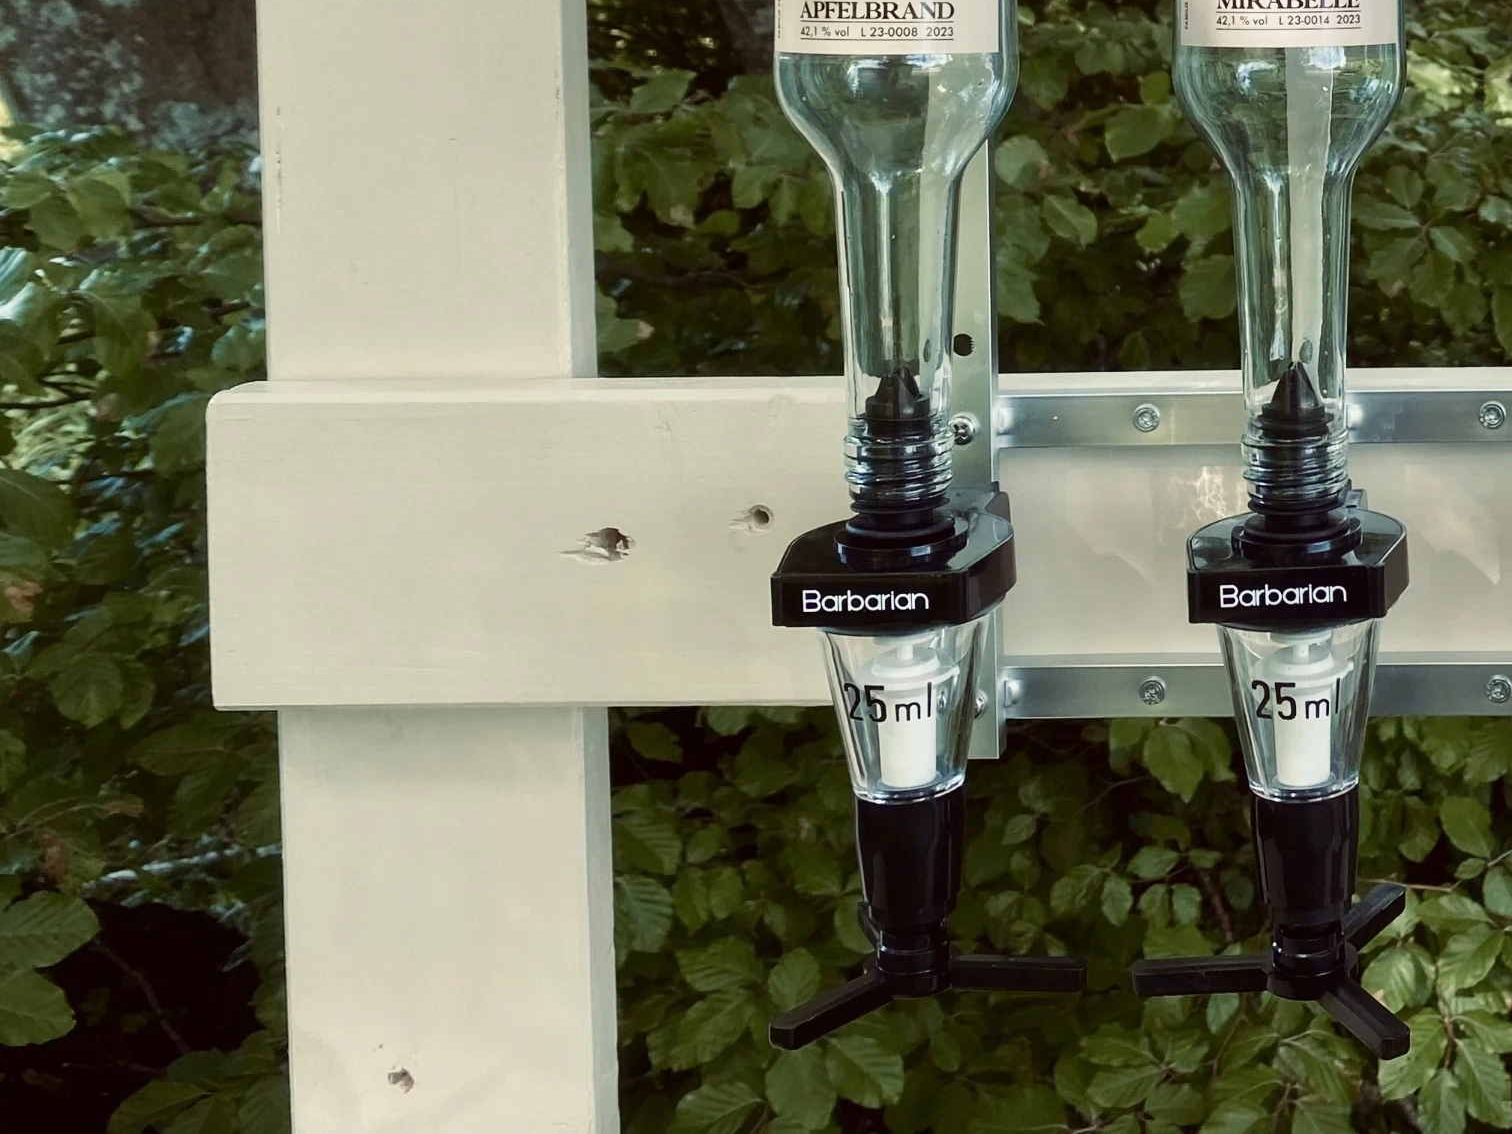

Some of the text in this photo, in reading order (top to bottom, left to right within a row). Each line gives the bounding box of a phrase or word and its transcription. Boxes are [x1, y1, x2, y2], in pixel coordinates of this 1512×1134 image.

[800, 0, 955, 20] APFELBRAND
[1216, 14, 1361, 27] 42,1 % vol L 23-0014 2023
[800, 26, 954, 38] 42,1 % vol L 23-0008 2023
[801, 588, 930, 614] Barbarian
[1219, 582, 1348, 609] Barbarian
[843, 682, 933, 723] 25 ml
[1251, 677, 1340, 721] 25 ml
